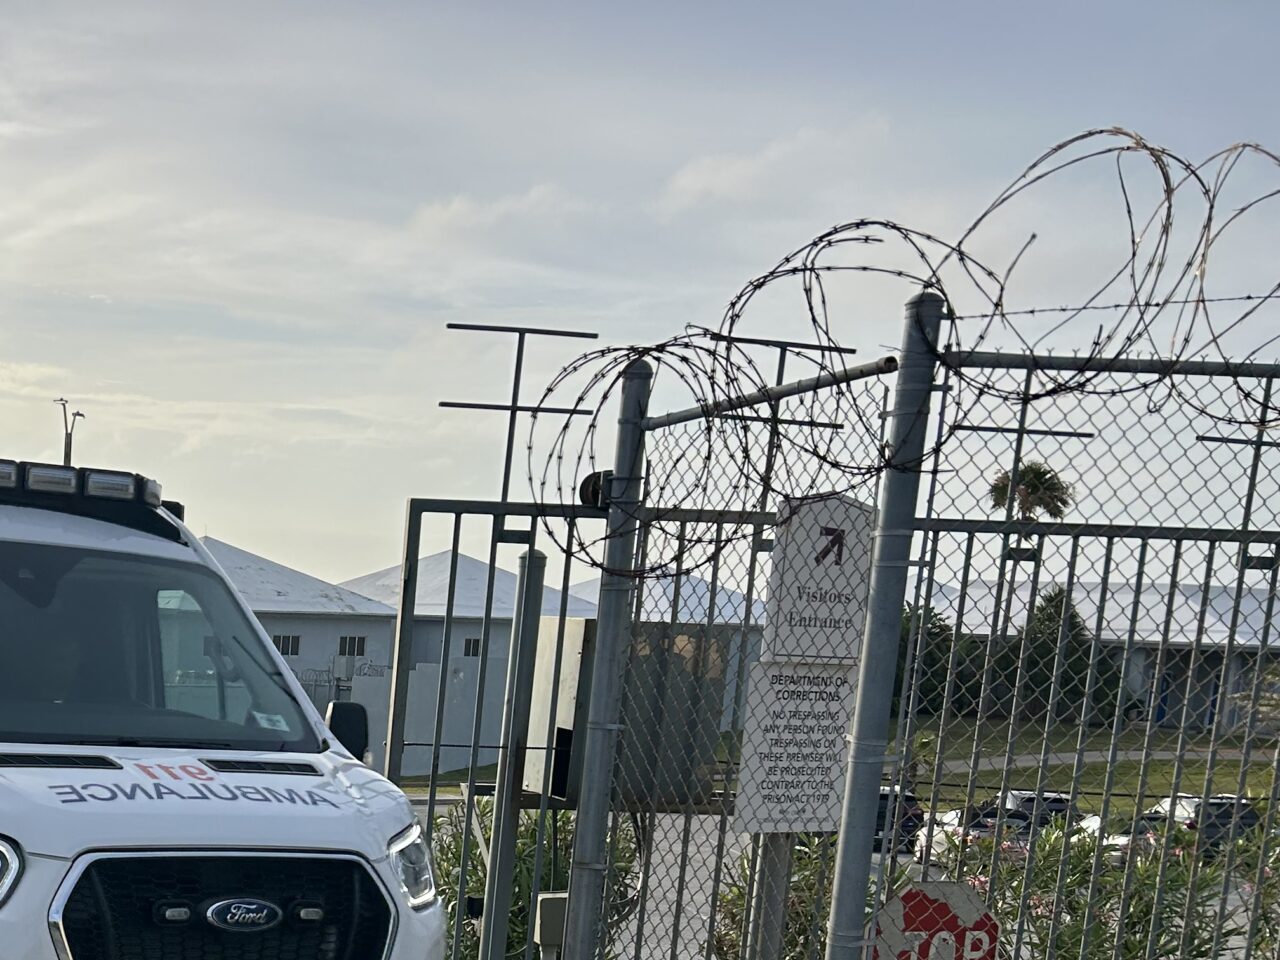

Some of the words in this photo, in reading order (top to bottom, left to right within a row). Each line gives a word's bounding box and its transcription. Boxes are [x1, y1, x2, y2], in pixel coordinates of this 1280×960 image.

[797, 586, 851, 604] Visitors
[789, 611, 851, 629] Entrance
[771, 674, 833, 687] DEPARTMENT
[835, 676, 848, 688] OF
[776, 689, 841, 702] CORRECTIONS
[772, 710, 786, 720] NO
[788, 710, 839, 721] TRESPASSING
[763, 724, 781, 734] ANY
[783, 724, 815, 735] PERSON
[817, 725, 845, 735] FOUND
[769, 738, 821, 748] TRESPASSING
[824, 739, 837, 749] ON
[759, 752, 784, 762] THESE
[786, 752, 824, 763] PREMISES
[767, 766, 779, 776] BE
[781, 766, 831, 776] PROSECUTED
[807, 780, 817, 790] TO
[820, 780, 834, 790] THE
[763, 793, 793, 804] PRISON
[794, 793, 810, 804] ACT
[227, 903, 268, 924] Ford
